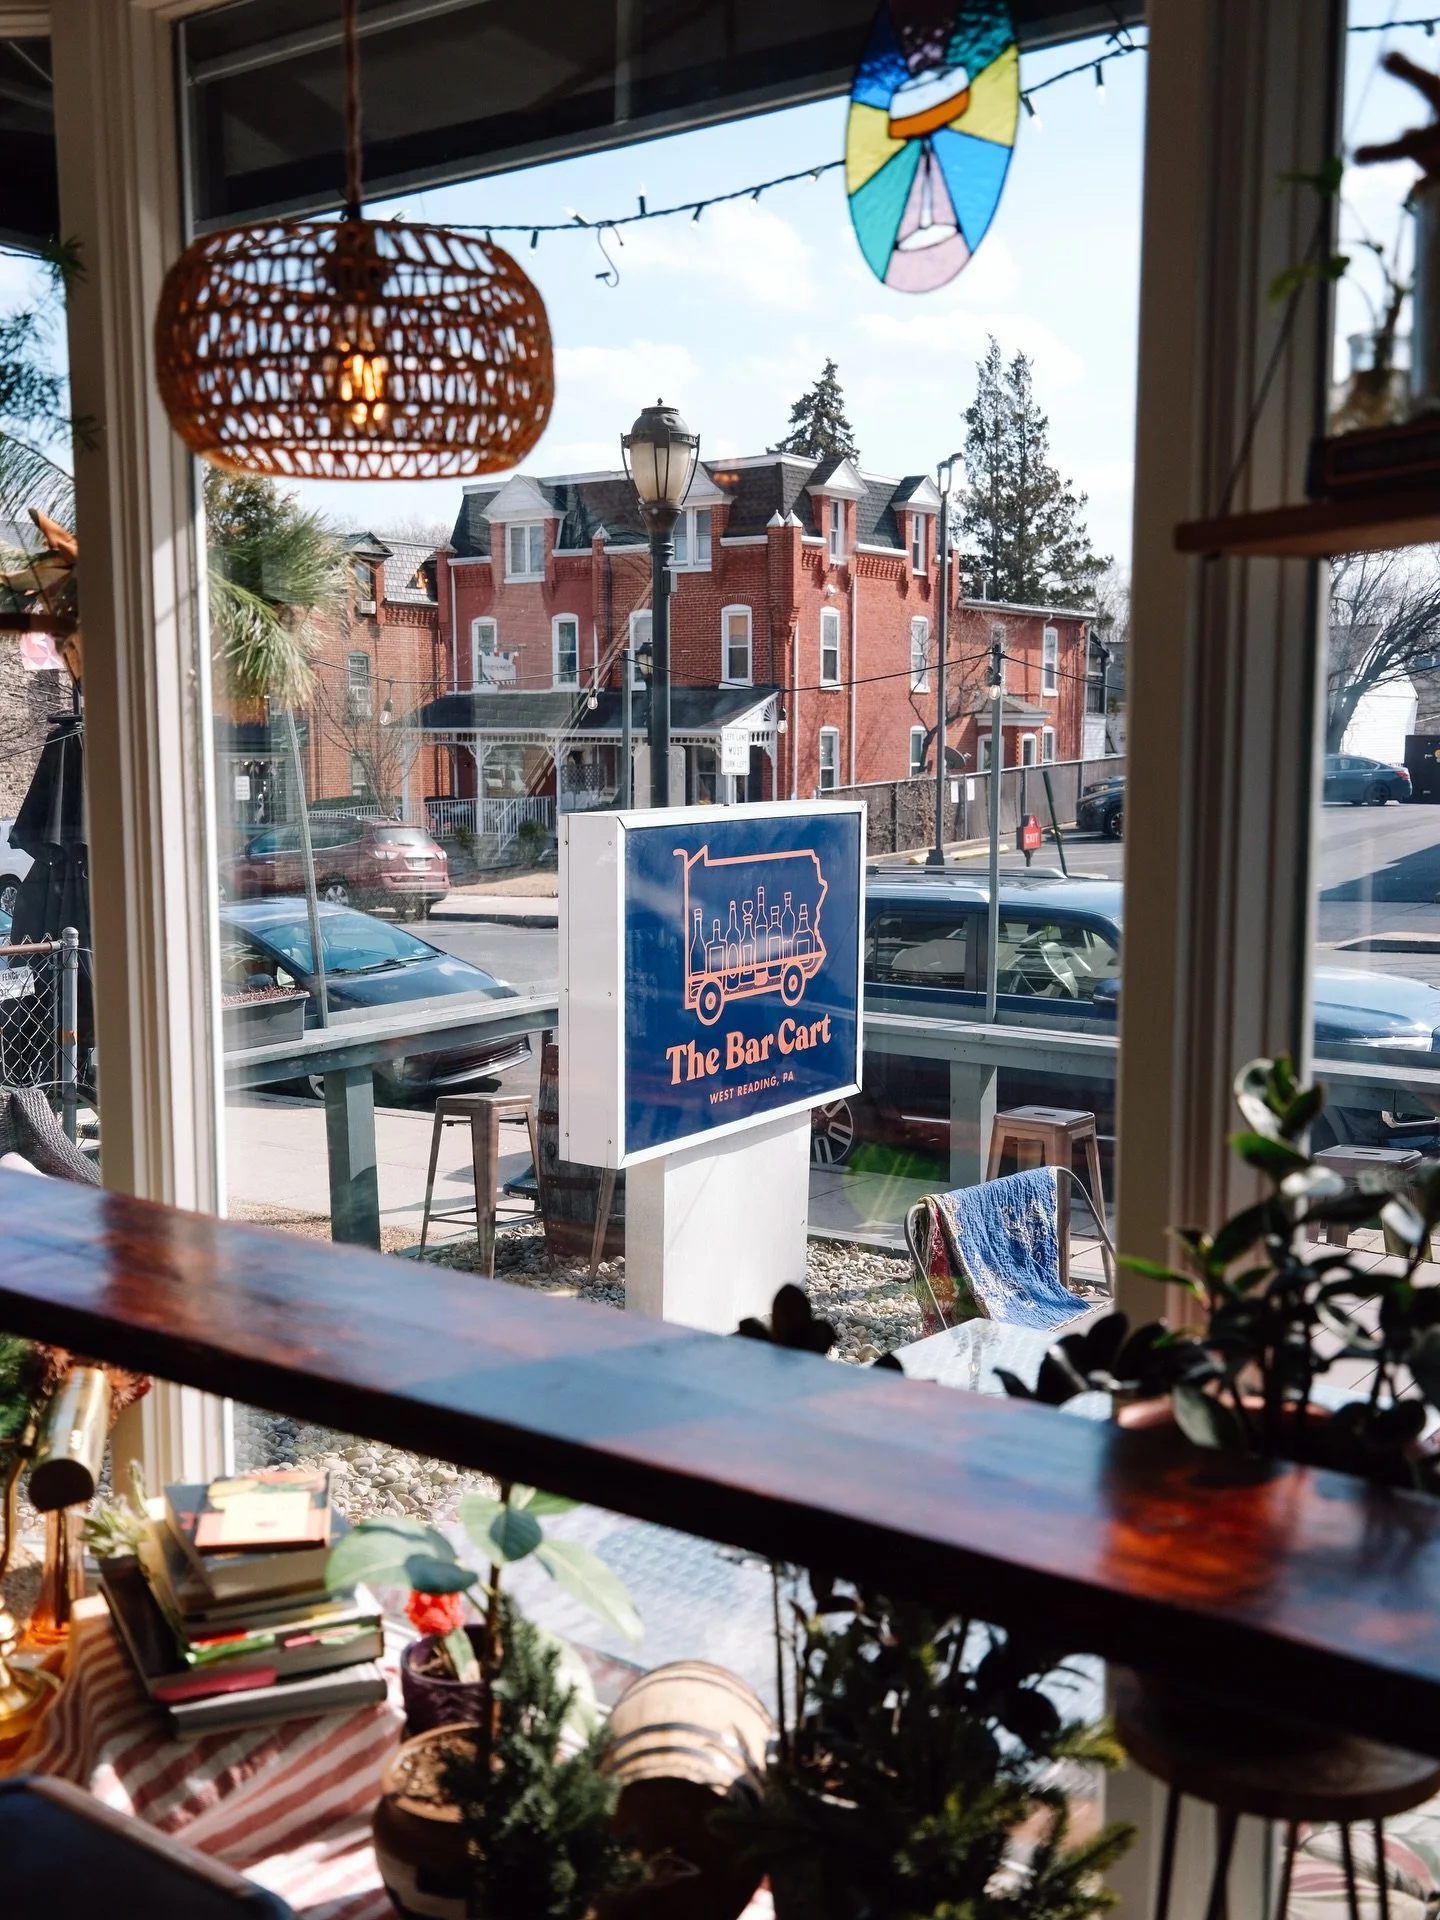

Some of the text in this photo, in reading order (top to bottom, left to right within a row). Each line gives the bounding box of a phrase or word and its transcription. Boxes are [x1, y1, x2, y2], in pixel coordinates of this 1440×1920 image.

[1025, 833, 1038, 844] EXIT
[666, 1013, 832, 1085] The Bar Cart
[709, 1071, 794, 1104] WEST READING, PA
